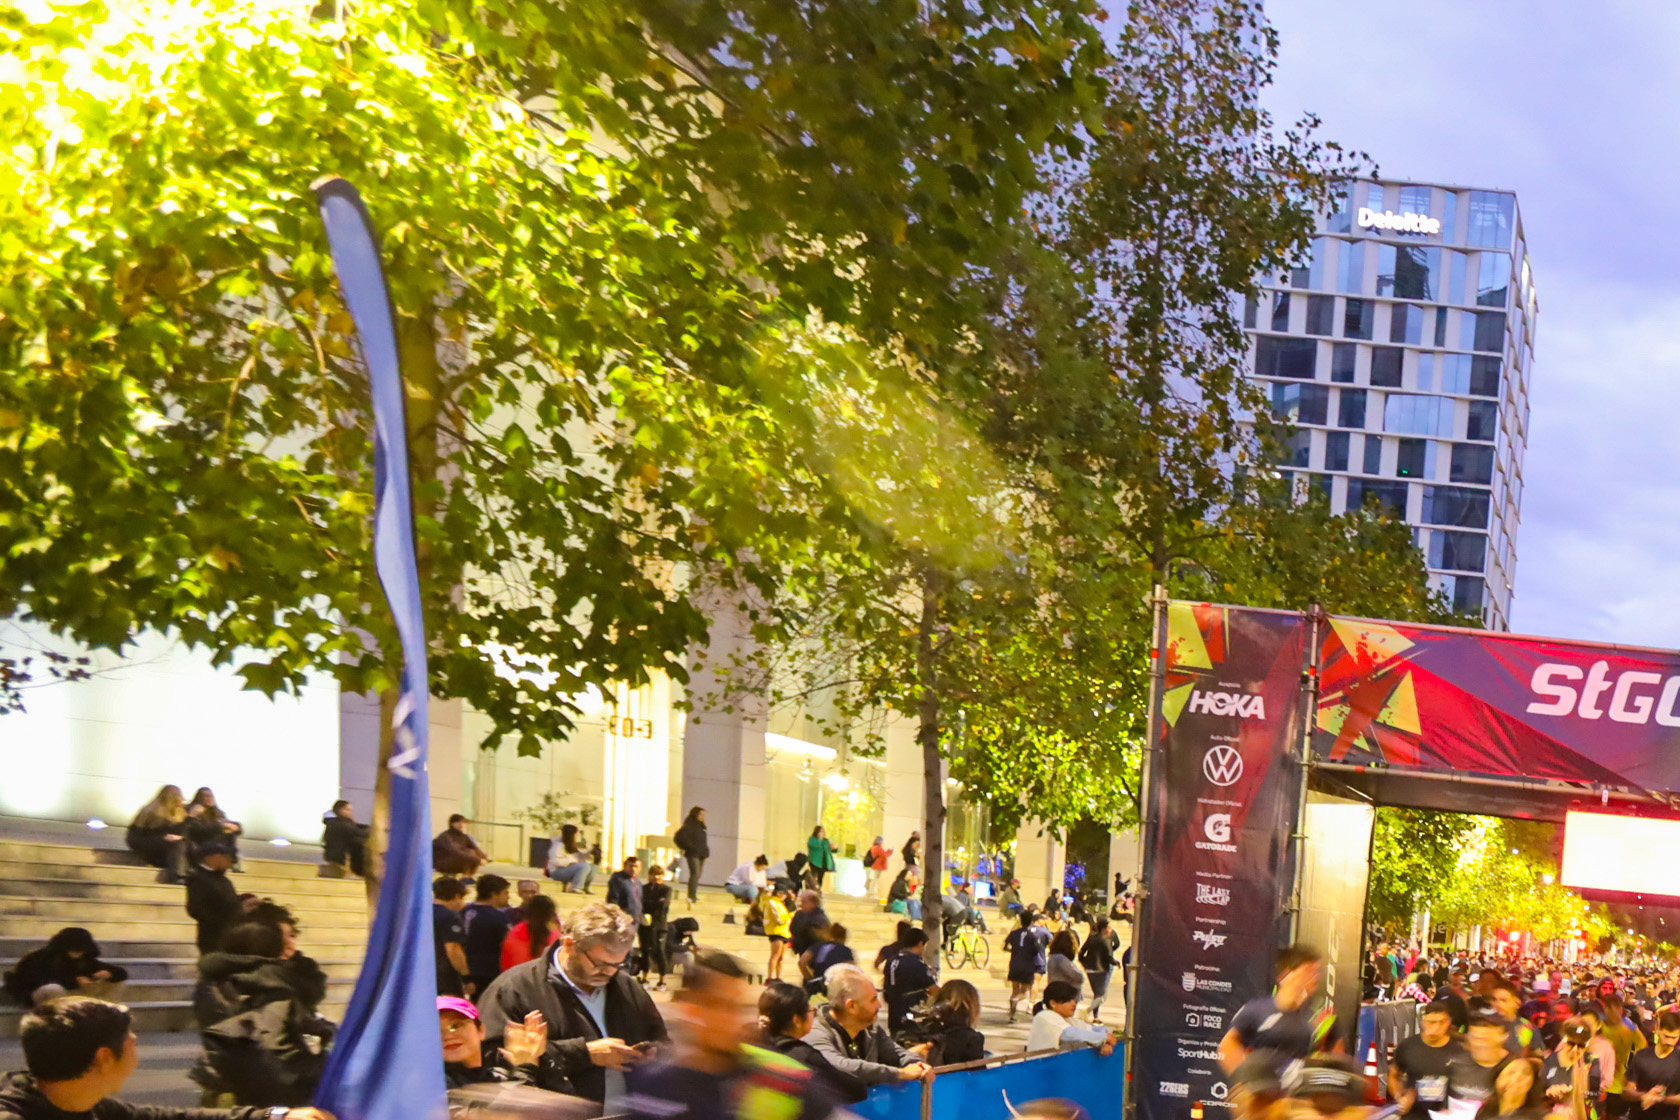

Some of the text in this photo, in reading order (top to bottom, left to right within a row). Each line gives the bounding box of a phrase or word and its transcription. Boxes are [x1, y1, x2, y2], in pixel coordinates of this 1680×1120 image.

[1357, 207, 1441, 234] Deloitte
[1189, 690, 1266, 720] HOKA
[1195, 842, 1237, 852] GATORADE
[1212, 886, 1230, 896] LAST
[1203, 1021, 1222, 1029] RACE
[1177, 1048, 1218, 1060] SportHub
